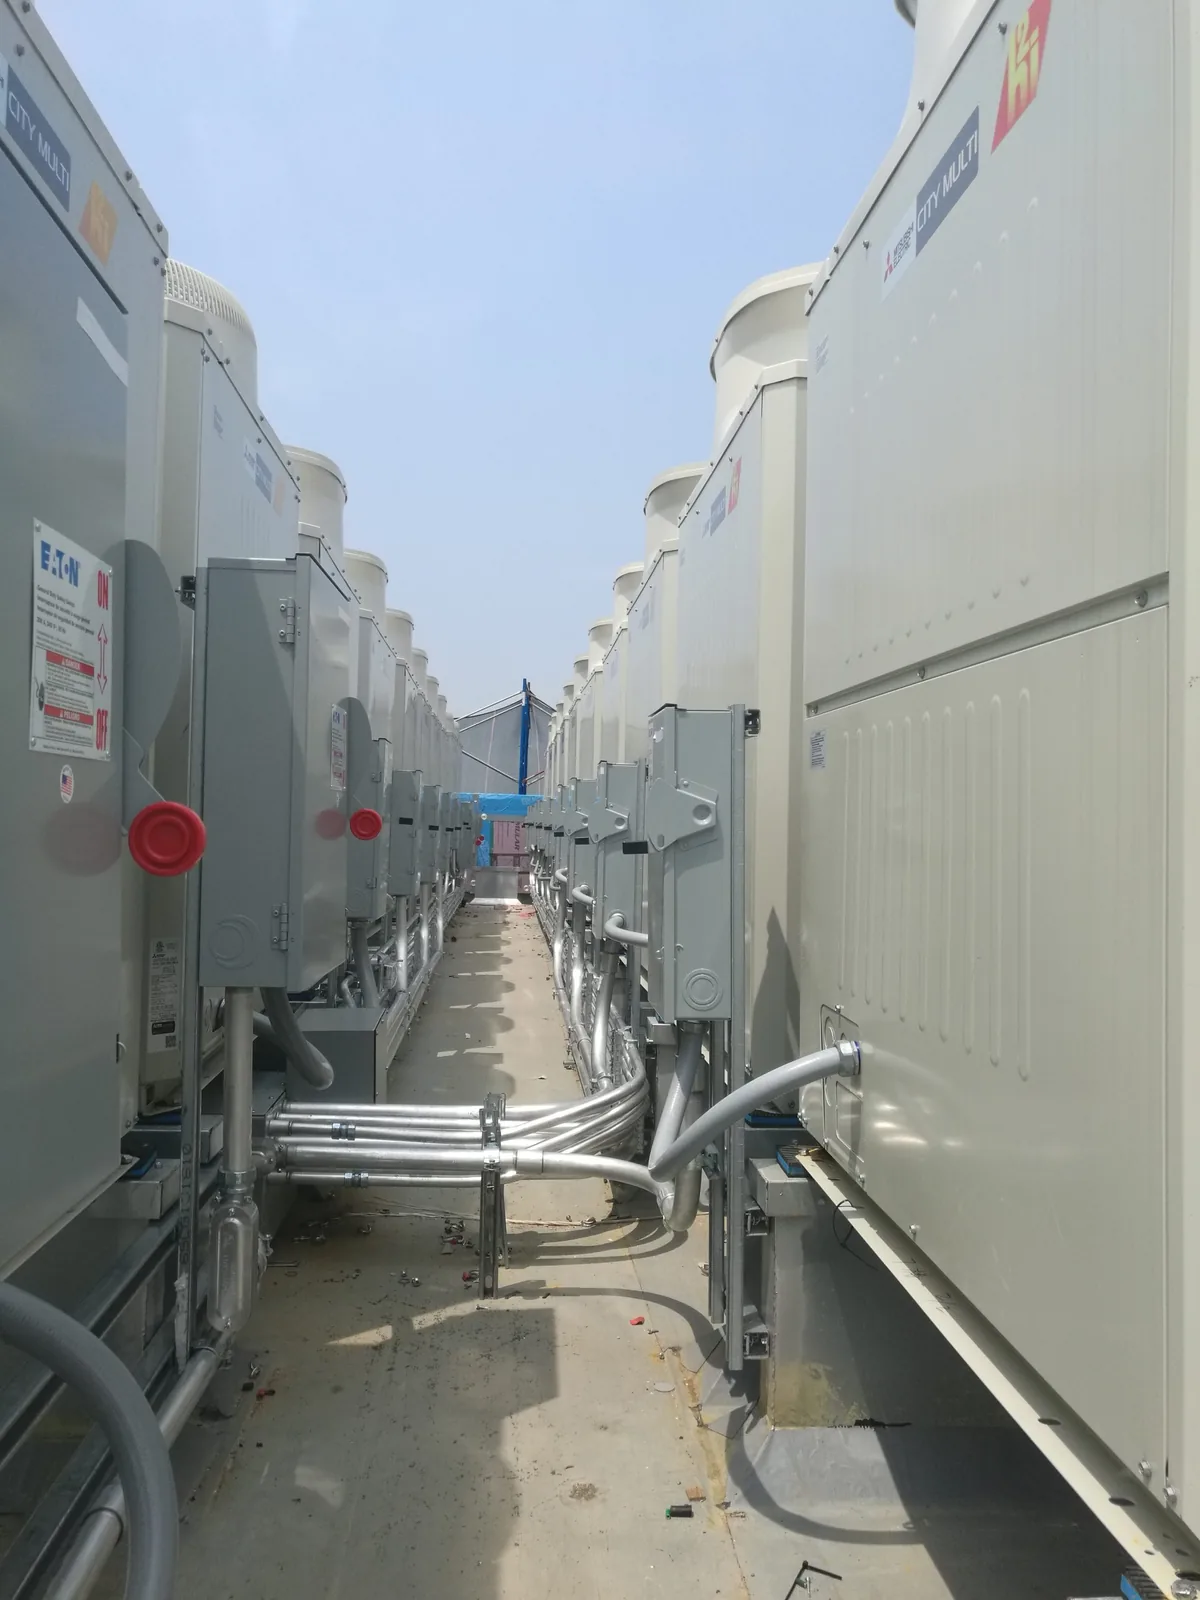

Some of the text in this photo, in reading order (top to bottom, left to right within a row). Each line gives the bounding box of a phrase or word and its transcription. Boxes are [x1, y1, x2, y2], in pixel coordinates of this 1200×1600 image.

[9, 91, 70, 192] CITY MULTI
[917, 130, 978, 231] CITY MULTI
[40, 540, 79, 587] EATON
[97, 569, 109, 610] ON
[96, 708, 108, 751] OFF
